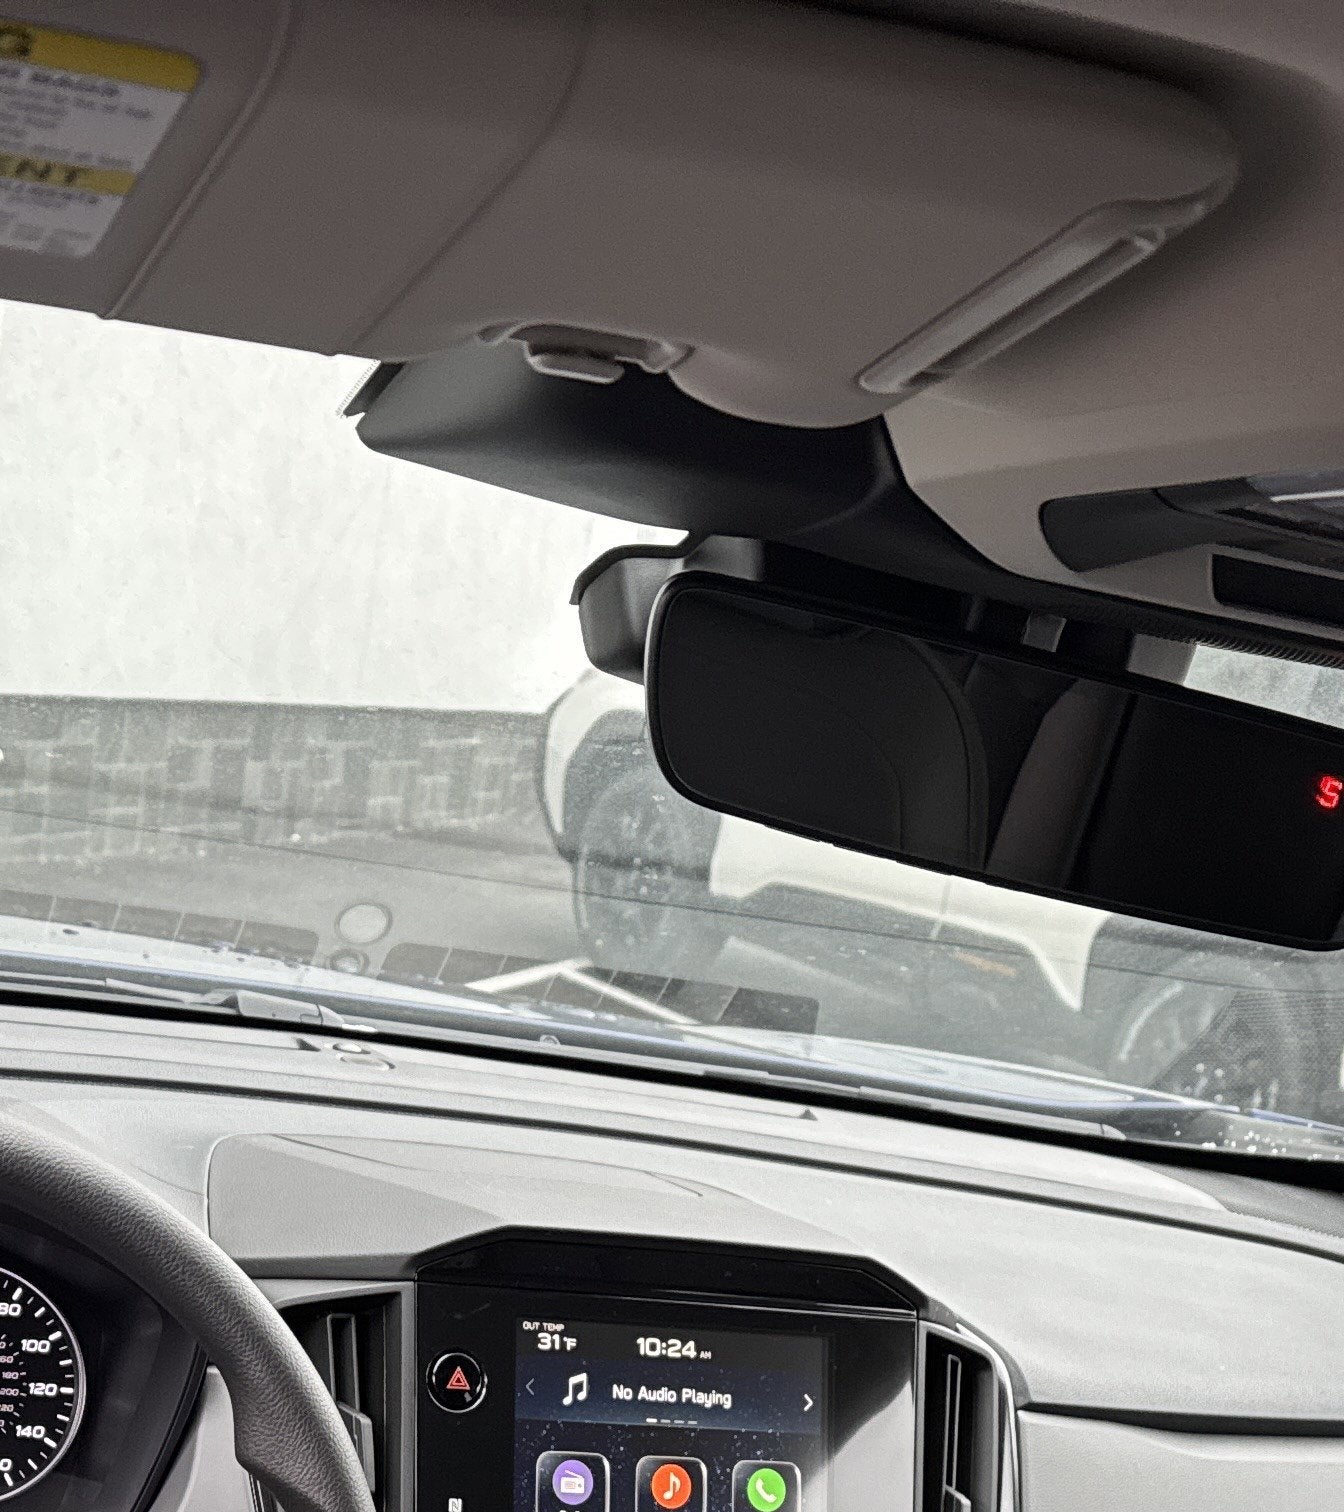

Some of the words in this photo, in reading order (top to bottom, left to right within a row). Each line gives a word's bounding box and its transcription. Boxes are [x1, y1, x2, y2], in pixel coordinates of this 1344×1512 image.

[522, 1321, 541, 1331] OUT
[21, 1339, 51, 1353] 100
[636, 1337, 697, 1359] 10:24
[699, 1351, 713, 1360] AM
[28, 1383, 58, 1397] 120
[612, 1384, 633, 1401] No
[637, 1385, 677, 1403] Audio
[681, 1388, 733, 1410] Playing
[15, 1424, 46, 1440] 140
